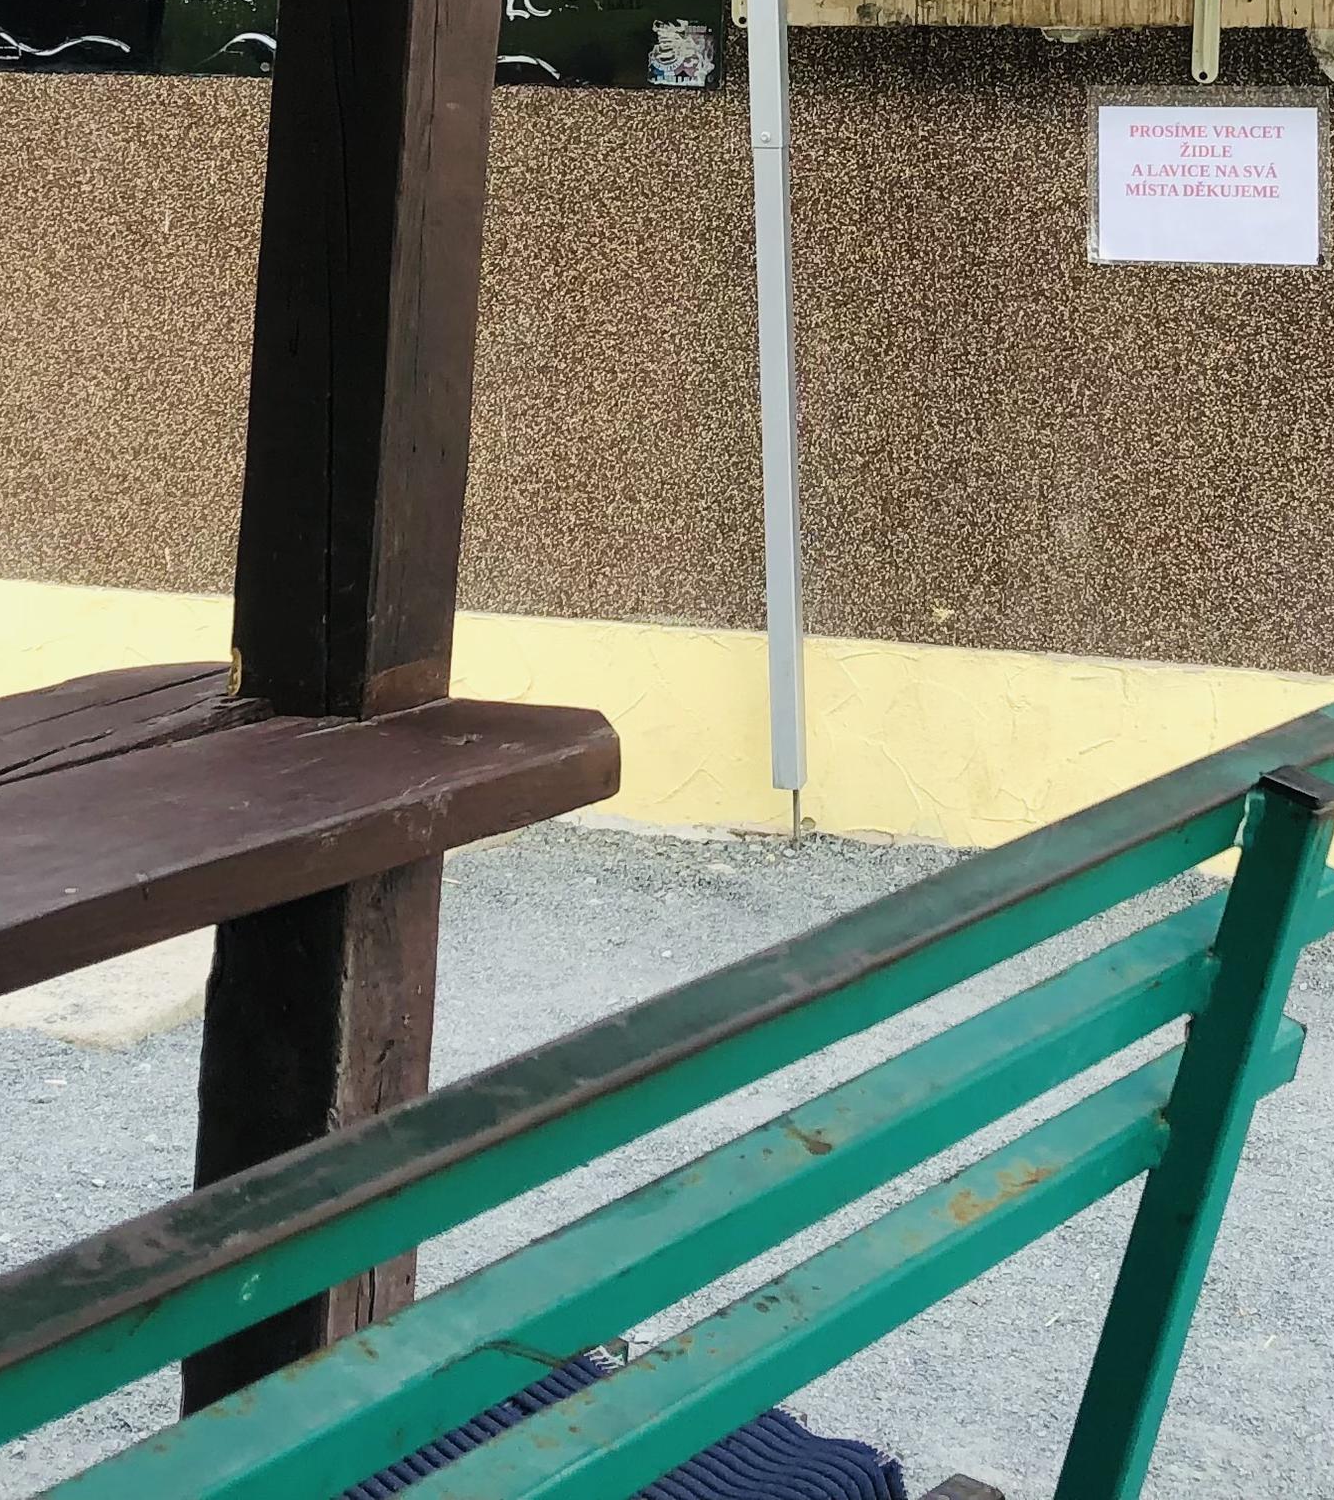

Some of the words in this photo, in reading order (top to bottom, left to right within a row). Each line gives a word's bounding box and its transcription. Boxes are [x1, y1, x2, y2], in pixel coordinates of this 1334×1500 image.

[1129, 122, 1208, 138] PROSÍME
[1213, 125, 1284, 139] VRACET
[1179, 142, 1232, 158] ŽIDLE
[1131, 164, 1144, 177] A
[1147, 164, 1210, 178] LAVICE
[1215, 165, 1239, 178] NA
[1244, 162, 1277, 179] SVÁ
[1126, 180, 1179, 197] MÍSTA
[1183, 181, 1280, 198] DĚKUJEME
